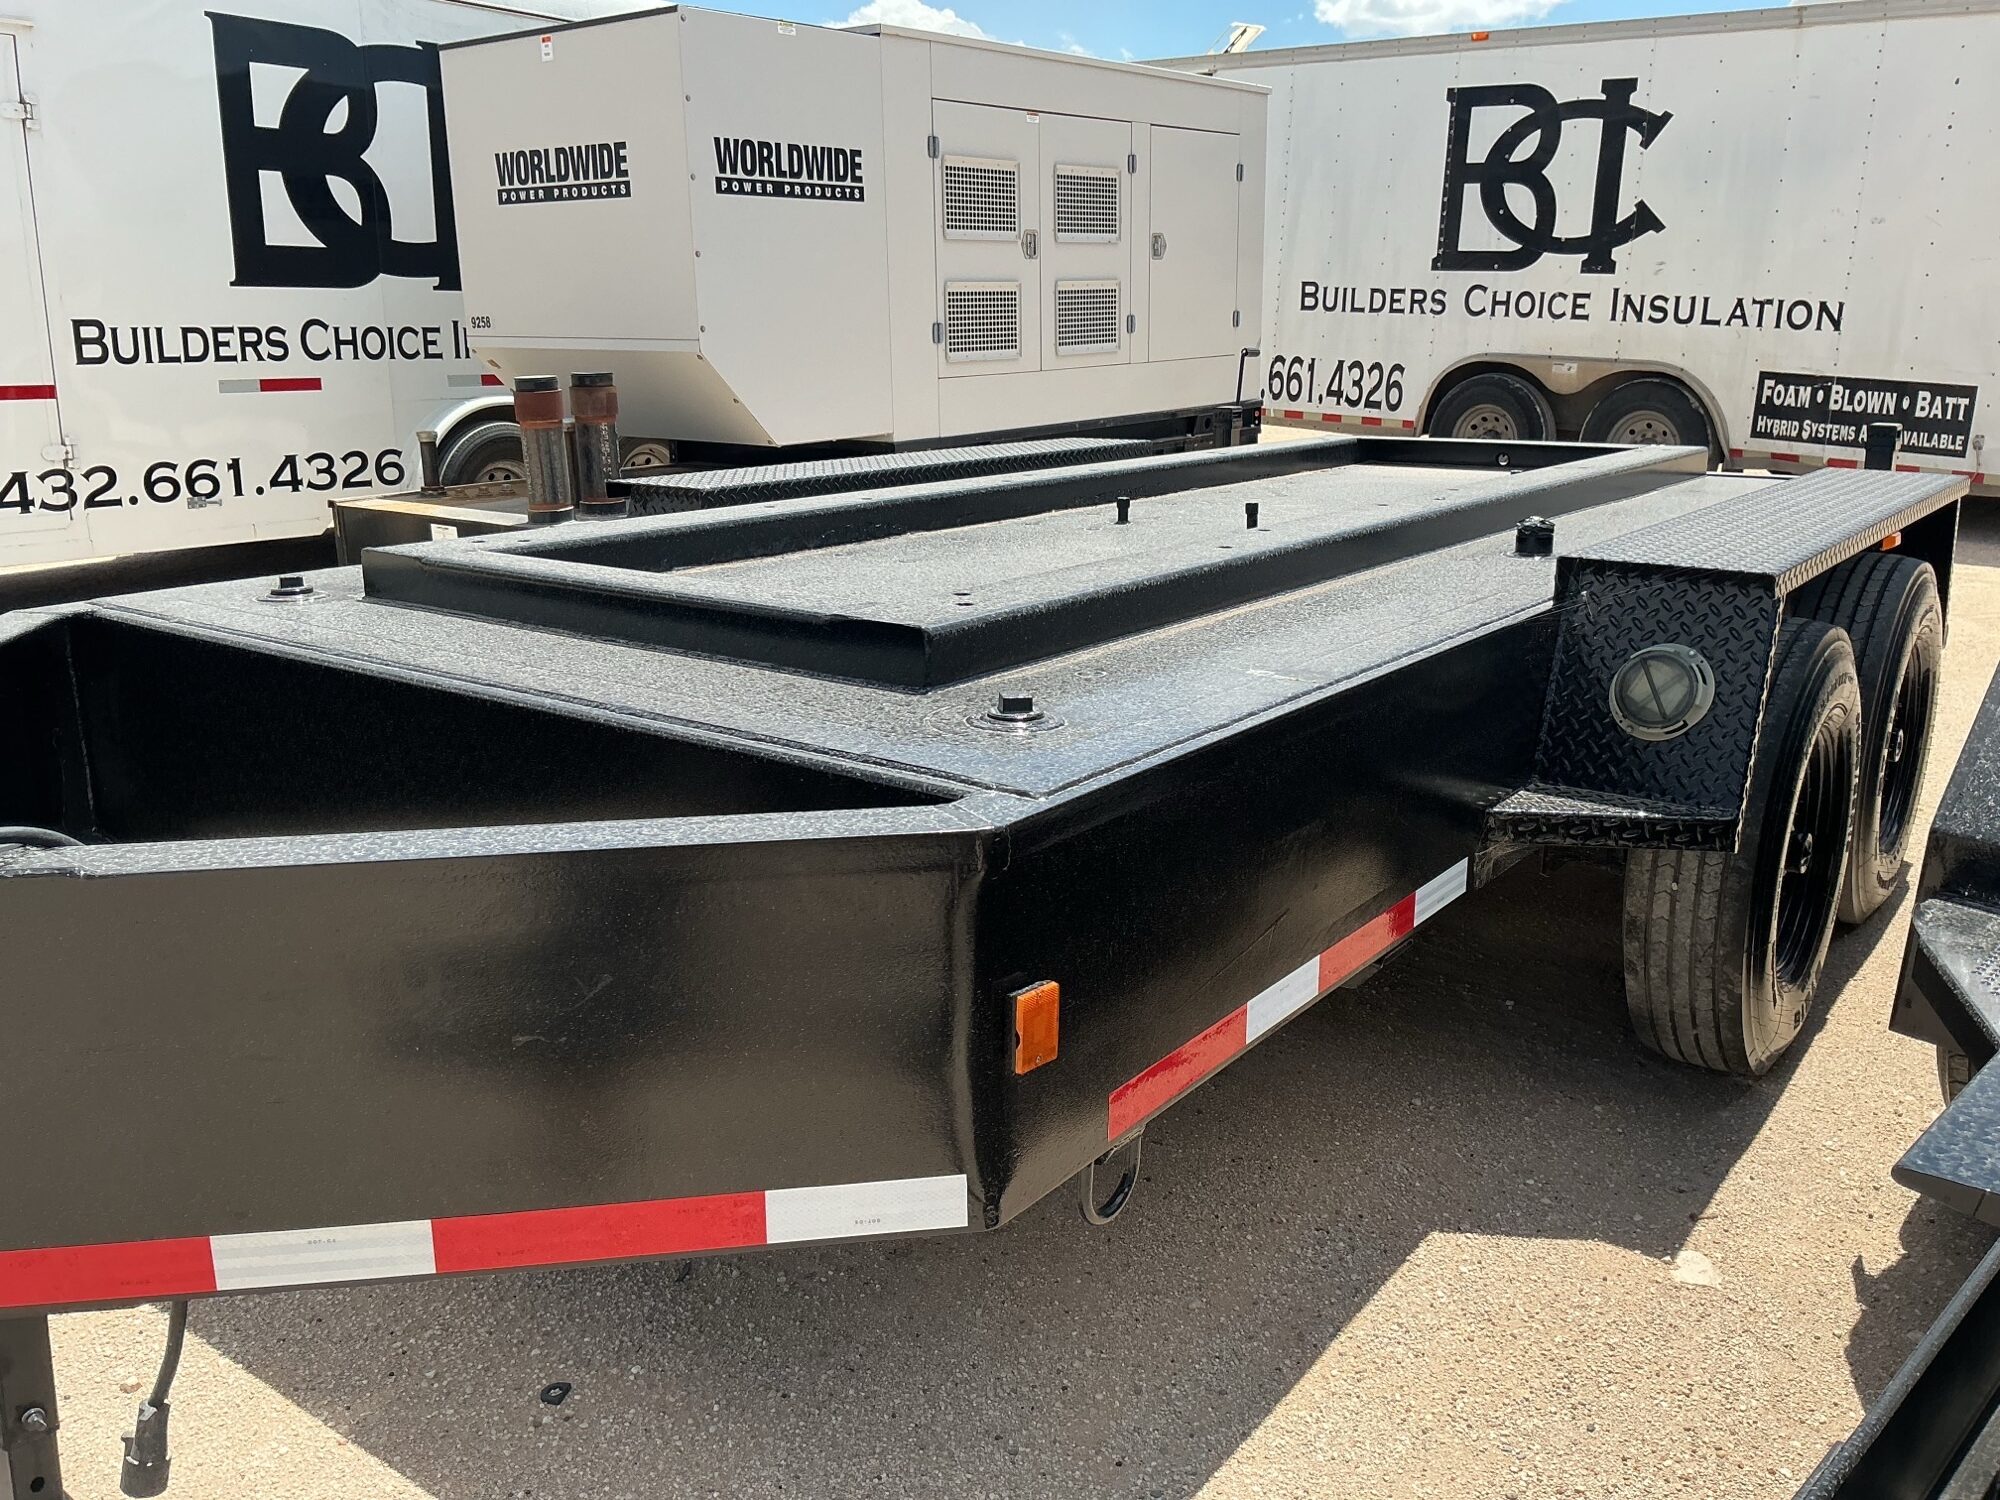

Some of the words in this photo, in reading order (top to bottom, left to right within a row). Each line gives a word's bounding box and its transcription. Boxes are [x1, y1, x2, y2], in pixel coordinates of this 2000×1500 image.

[494, 141, 629, 187] WORLDWIDE
[713, 136, 864, 184] WORLDWIDE
[502, 189, 545, 202] POWER
[553, 184, 627, 199] PRODUCTS
[721, 180, 774, 194] POWER
[784, 184, 861, 199] PRODUCTS
[470, 316, 491, 329] 9258
[1300, 281, 1448, 316] BUILDERS
[1464, 284, 1592, 321] CHOICE
[1609, 287, 1846, 332] INSULATION
[71, 318, 291, 366] BUILDERS
[300, 318, 444, 361] CHOICE
[1260, 354, 1406, 412] .661.4326
[1761, 379, 1812, 409] FOAM
[1829, 384, 1898, 416] BLOWN
[1914, 390, 1970, 422] BATT
[1756, 415, 1800, 438] HYBRID
[1802, 419, 1856, 443] SYSTEMS
[1900, 430, 1965, 451] VAILABLE
[0, 448, 407, 515] 432.661.4326
